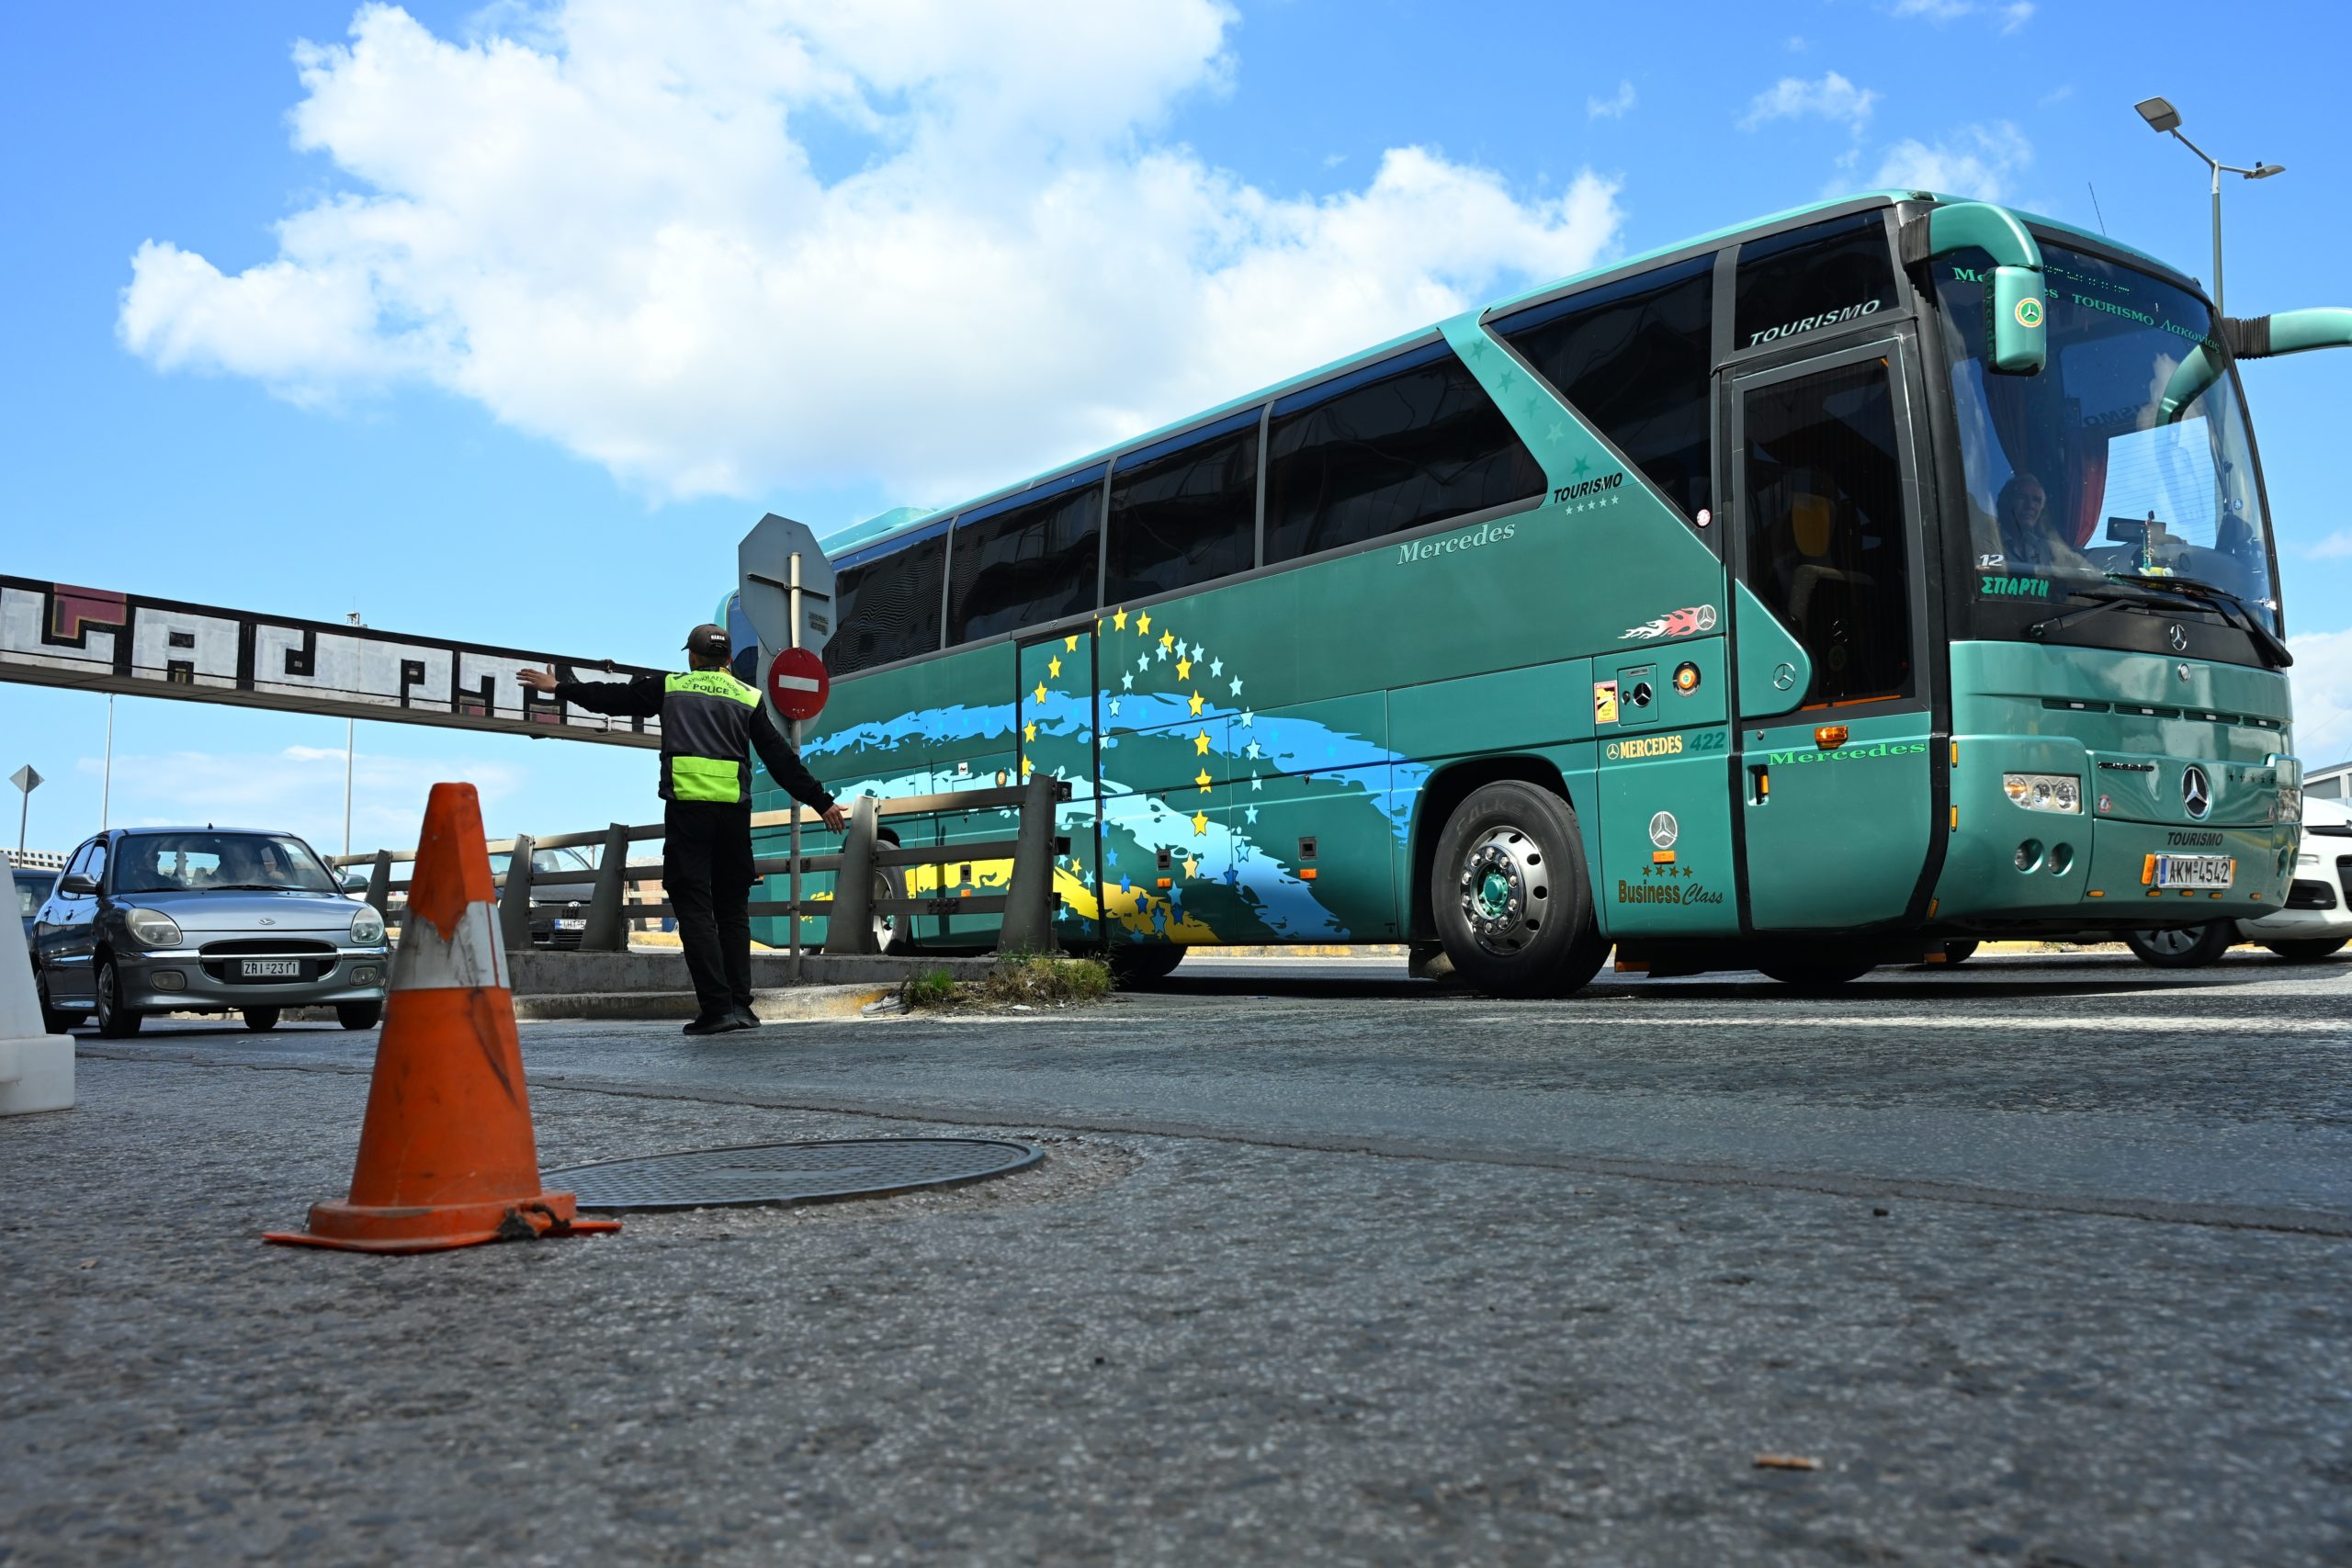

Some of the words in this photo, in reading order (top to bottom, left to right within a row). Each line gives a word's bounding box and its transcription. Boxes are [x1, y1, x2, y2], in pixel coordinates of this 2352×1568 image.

[1750, 299, 1881, 347] TOURISMO
[2072, 293, 2154, 326] TOURISMO
[2159, 319, 2221, 354] Λακωνίας
[1554, 472, 1623, 504] TOURISMO
[1396, 522, 1516, 566] Mercedes
[1979, 554, 2005, 567] 12
[1981, 576, 2050, 597] ΣΠΑΡΤΗ
[693, 683, 729, 695] POLICE
[1620, 735, 1683, 759] MERCEDES
[1690, 730, 1725, 751] 422
[1767, 742, 1927, 767] Mercedes
[2167, 831, 2223, 846] TOURISMO
[2169, 861, 2228, 883] AKM-4542
[1618, 879, 1680, 904] Business
[1682, 883, 1724, 906] Class
